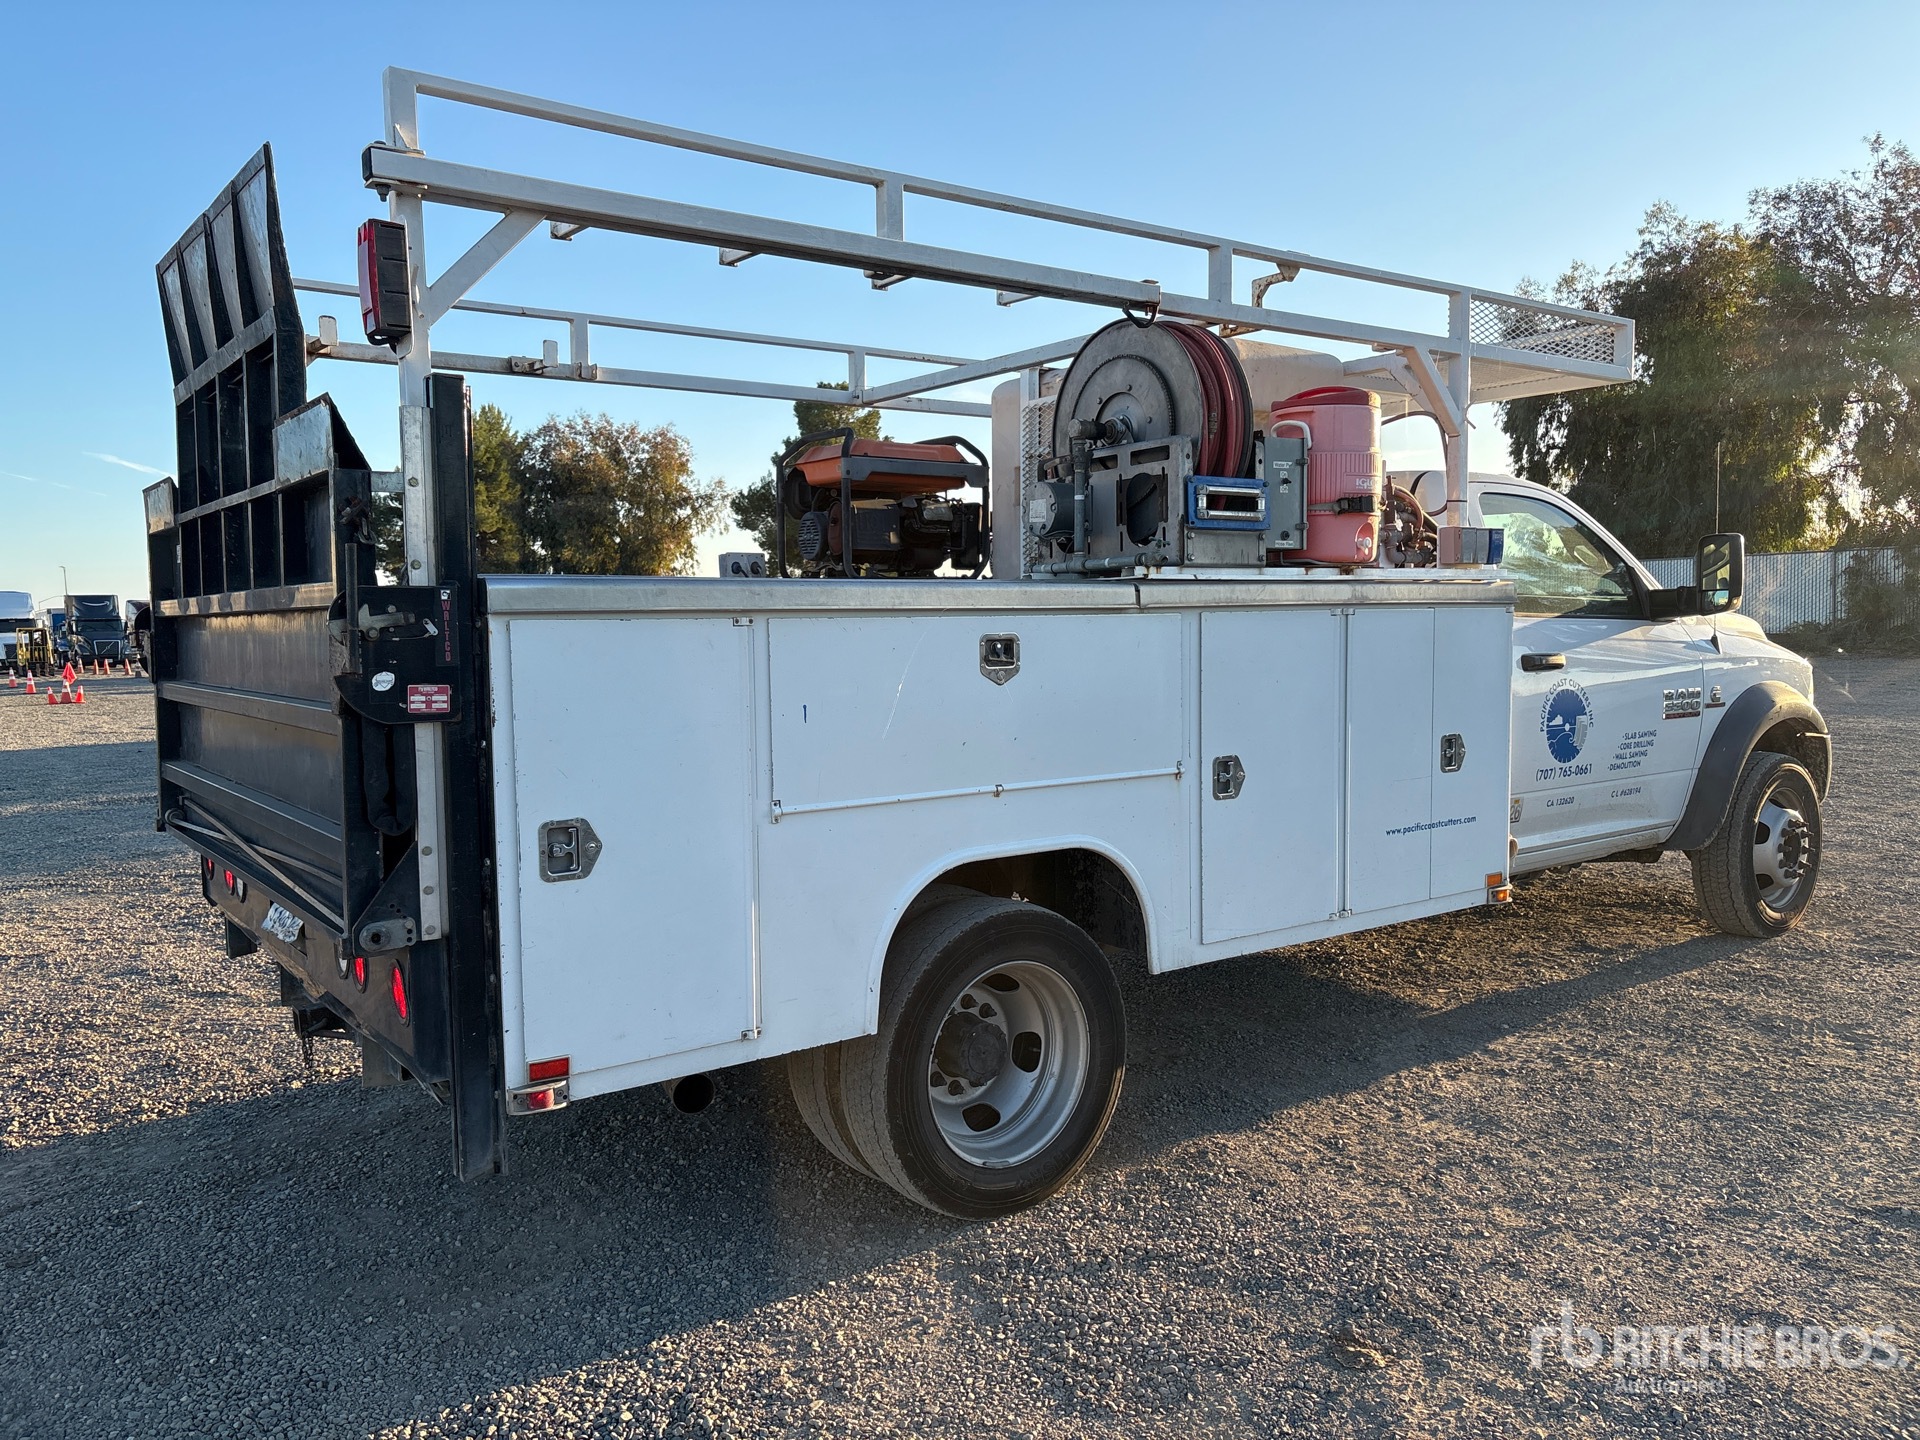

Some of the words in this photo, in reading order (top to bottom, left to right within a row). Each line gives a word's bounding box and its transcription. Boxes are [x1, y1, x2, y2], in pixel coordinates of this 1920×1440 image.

[441, 601, 451, 662] WALTCO
[1663, 687, 1701, 700] RAM
[1540, 695, 1550, 732] PACIFIC
[1549, 678, 1567, 695] COAST
[1569, 679, 1591, 708] CUTTERS
[1663, 699, 1701, 712] 5500
[1638, 730, 1657, 739] SAWING
[1633, 740, 1654, 749] DRILLING
[1629, 749, 1648, 759] SAWING
[1535, 767, 1556, 782] (707)
[1558, 763, 1592, 778] 765-0661
[1546, 799, 1554, 807] CA
[1556, 796, 1574, 806] 132620
[1385, 816, 1477, 836] www.pacificcoastcutters.com
